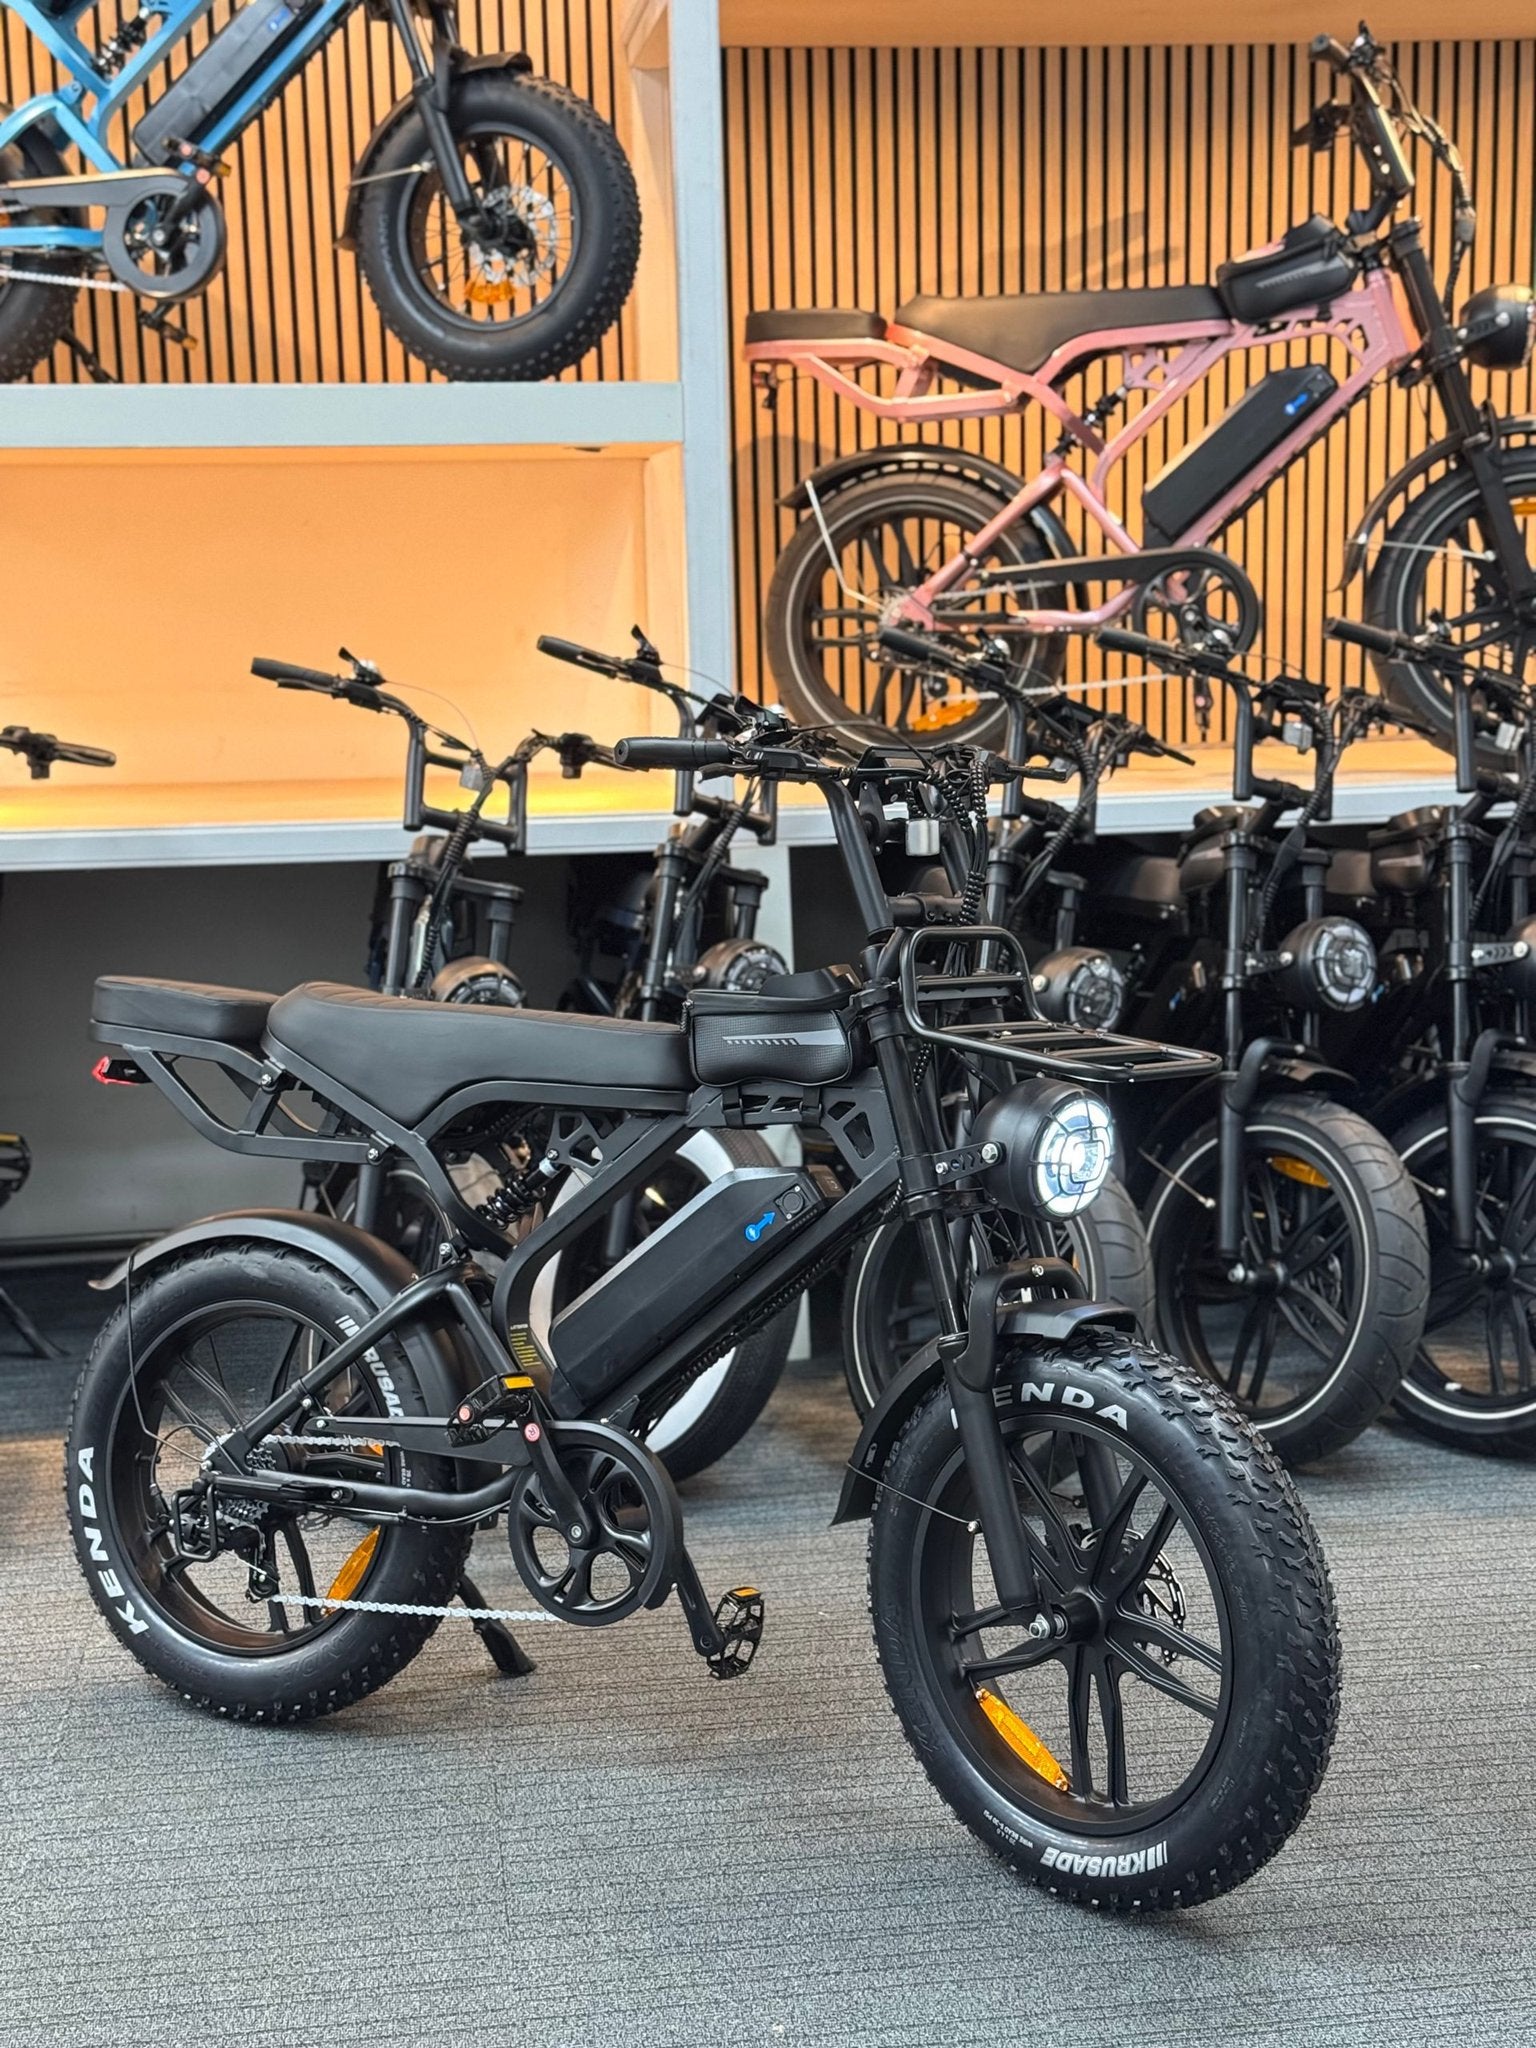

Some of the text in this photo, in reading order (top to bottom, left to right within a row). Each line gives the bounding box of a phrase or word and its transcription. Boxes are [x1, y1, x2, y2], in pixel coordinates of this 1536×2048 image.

[951, 1382, 1128, 1432] ENDA
[77, 1446, 150, 1635] KENDA
[1039, 1846, 1147, 1877] KRUSADE
